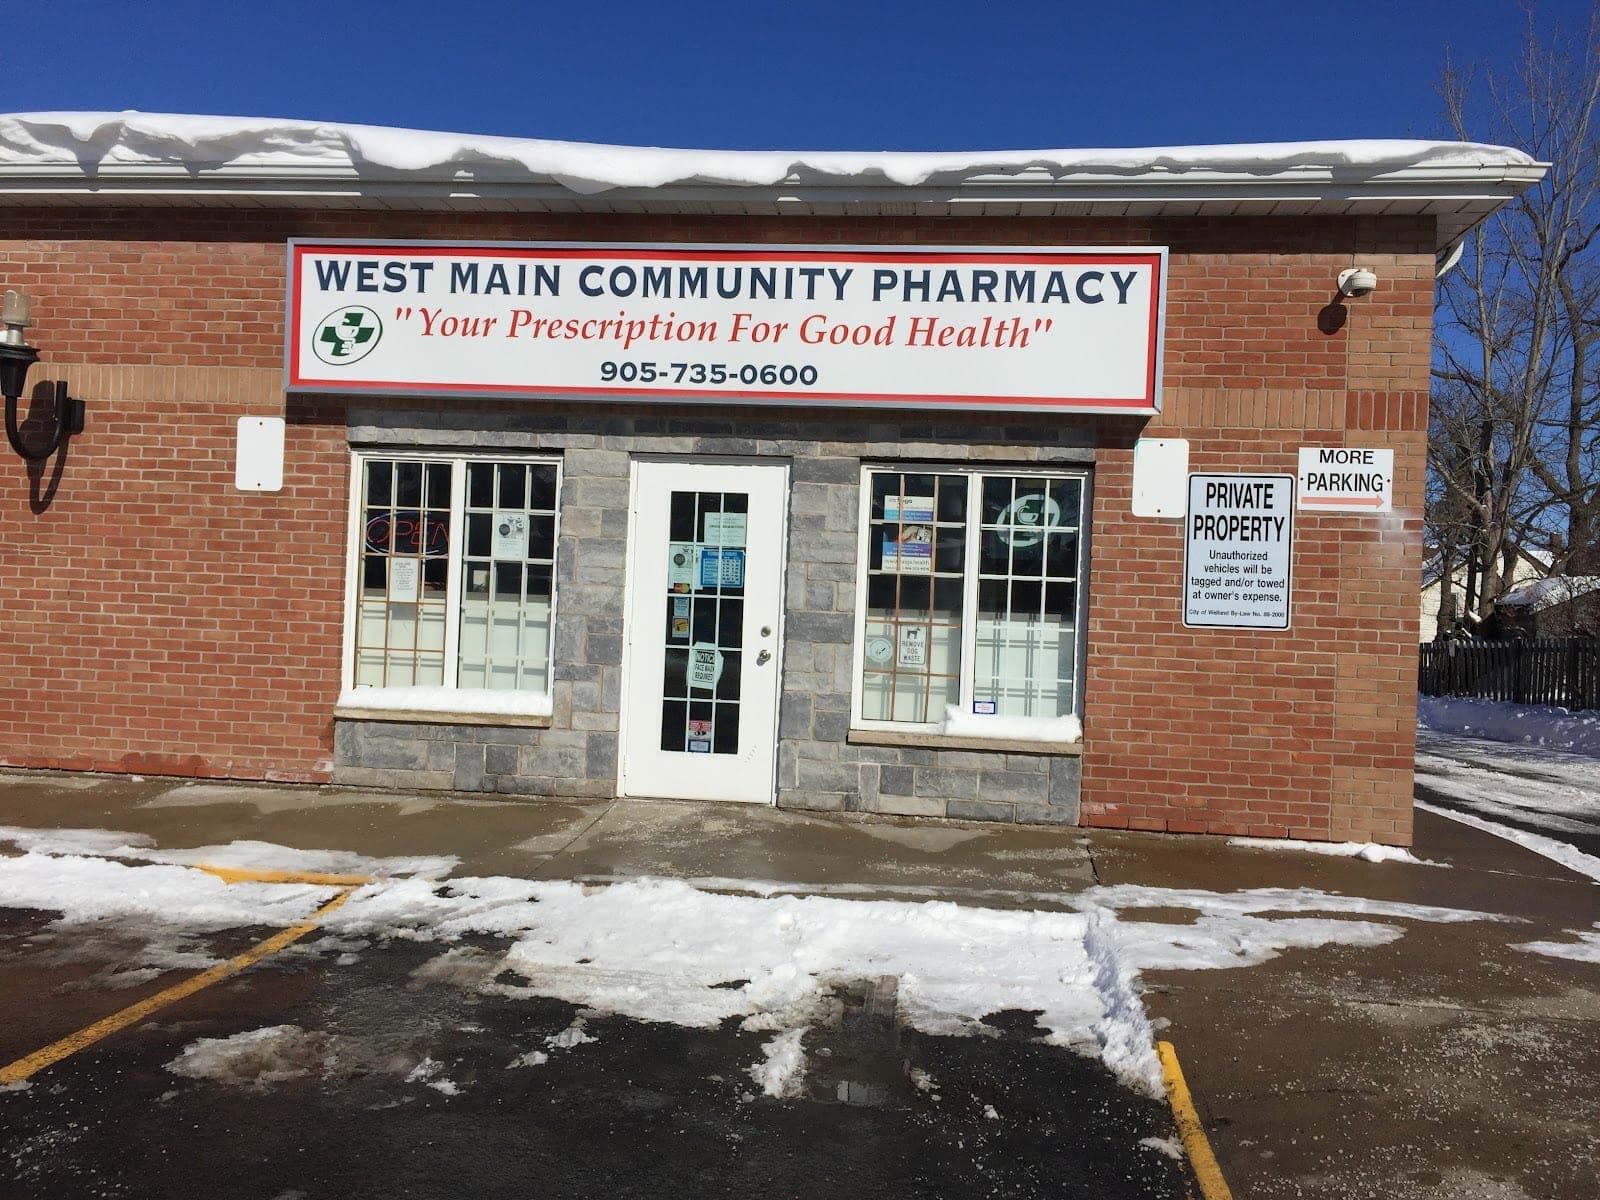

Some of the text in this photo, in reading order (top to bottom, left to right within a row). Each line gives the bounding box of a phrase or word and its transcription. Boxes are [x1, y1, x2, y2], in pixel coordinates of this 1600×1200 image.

[315, 260, 1138, 305] WEST MAIN COMMUNITY PHARMACY
[506, 310, 718, 350] Prescription
[728, 313, 789, 343] For
[800, 314, 897, 346] Good
[600, 361, 819, 386] 905-735-0600
[1319, 449, 1374, 465] MORE
[1307, 472, 1384, 493] PARKING
[1206, 482, 1274, 509] PRIVATE
[1193, 514, 1285, 542] PROPERTY
[1209, 549, 1268, 561] Unauthorized
[1204, 563, 1272, 575] vehicles will be
[1191, 576, 1285, 589] tagged and/or towed
[1192, 590, 1283, 604] at owner's expense.
